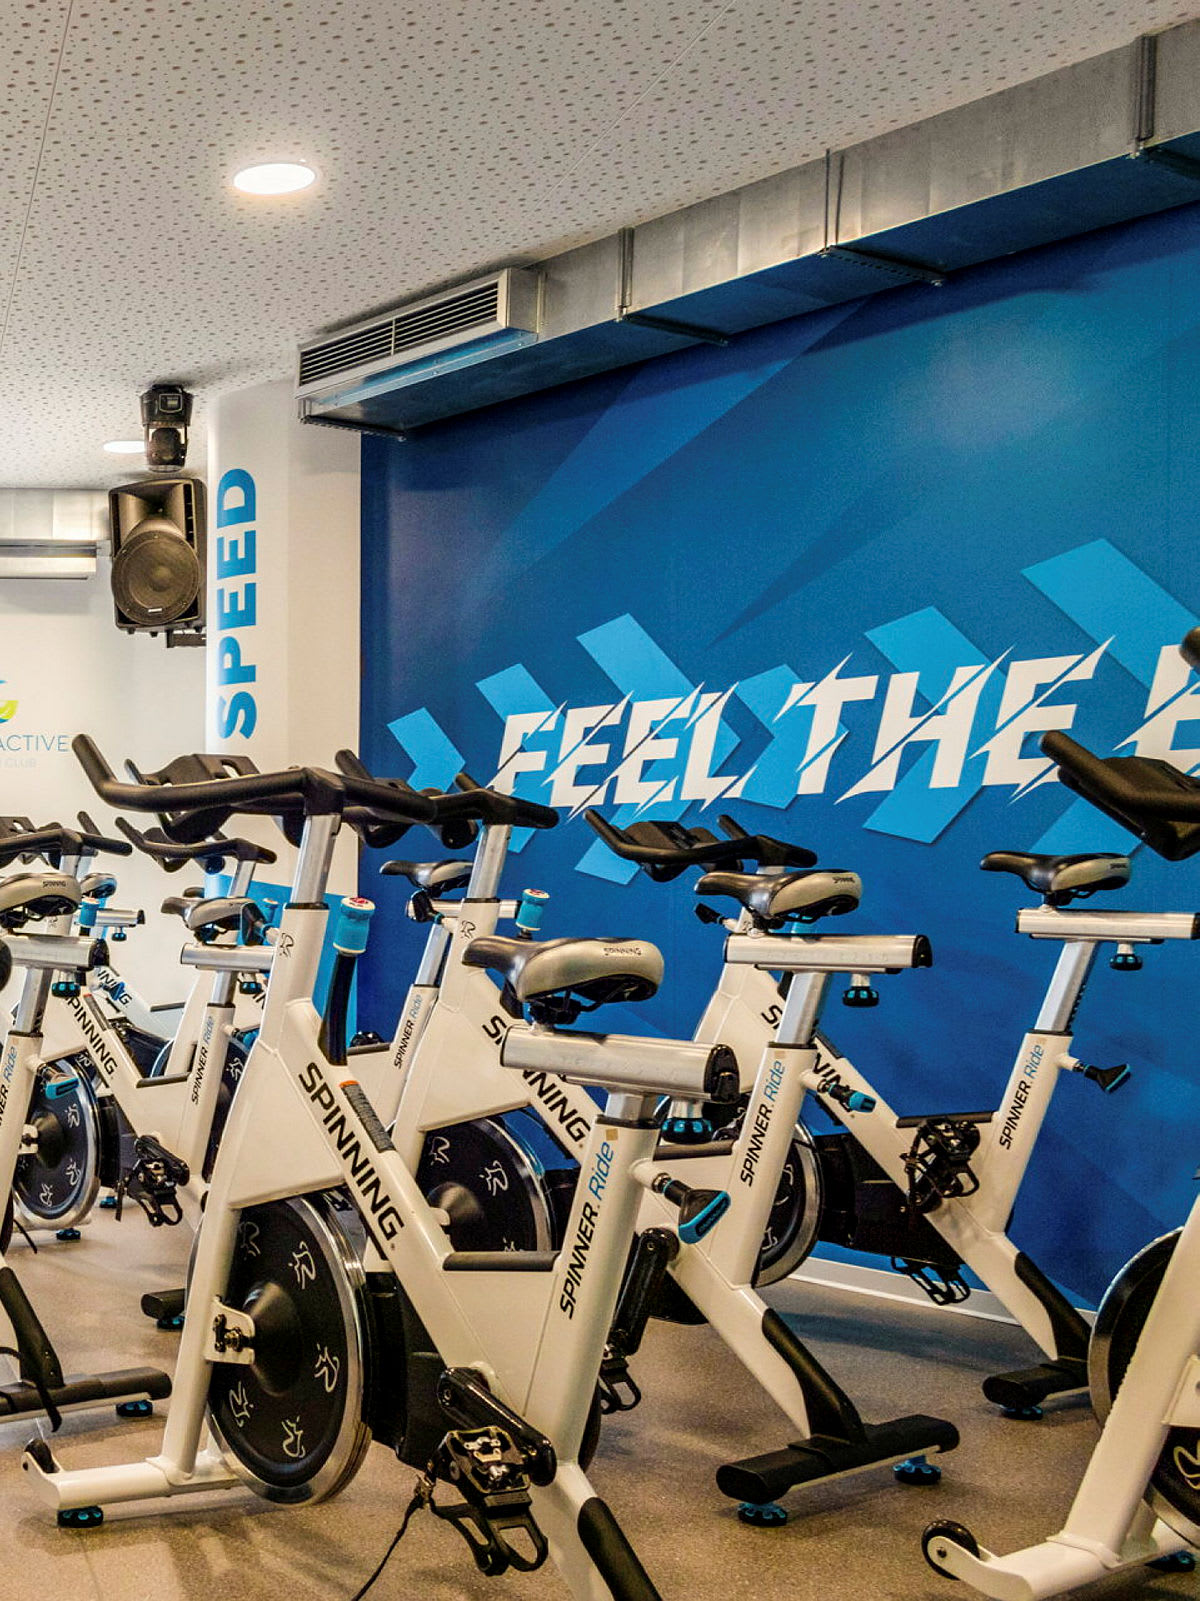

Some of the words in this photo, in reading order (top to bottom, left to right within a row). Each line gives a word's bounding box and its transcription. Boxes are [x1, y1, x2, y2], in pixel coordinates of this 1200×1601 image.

[216, 468, 256, 739] SPEED
[4, 757, 37, 769] CLUB
[486, 682, 758, 823] FEEL
[773, 635, 1115, 805] THE
[67, 996, 118, 1075] PINNING
[192, 1047, 208, 1105] SPINNER
[394, 1020, 415, 1069] SPINNER
[298, 1062, 405, 1241] SPINNING
[740, 1103, 773, 1187] SPINNER
[764, 1061, 786, 1102] Ride
[999, 1080, 1031, 1150] SPINNER
[1024, 1045, 1044, 1079] Ride
[560, 1202, 599, 1319] SPINNER
[589, 1141, 614, 1200] Ride
